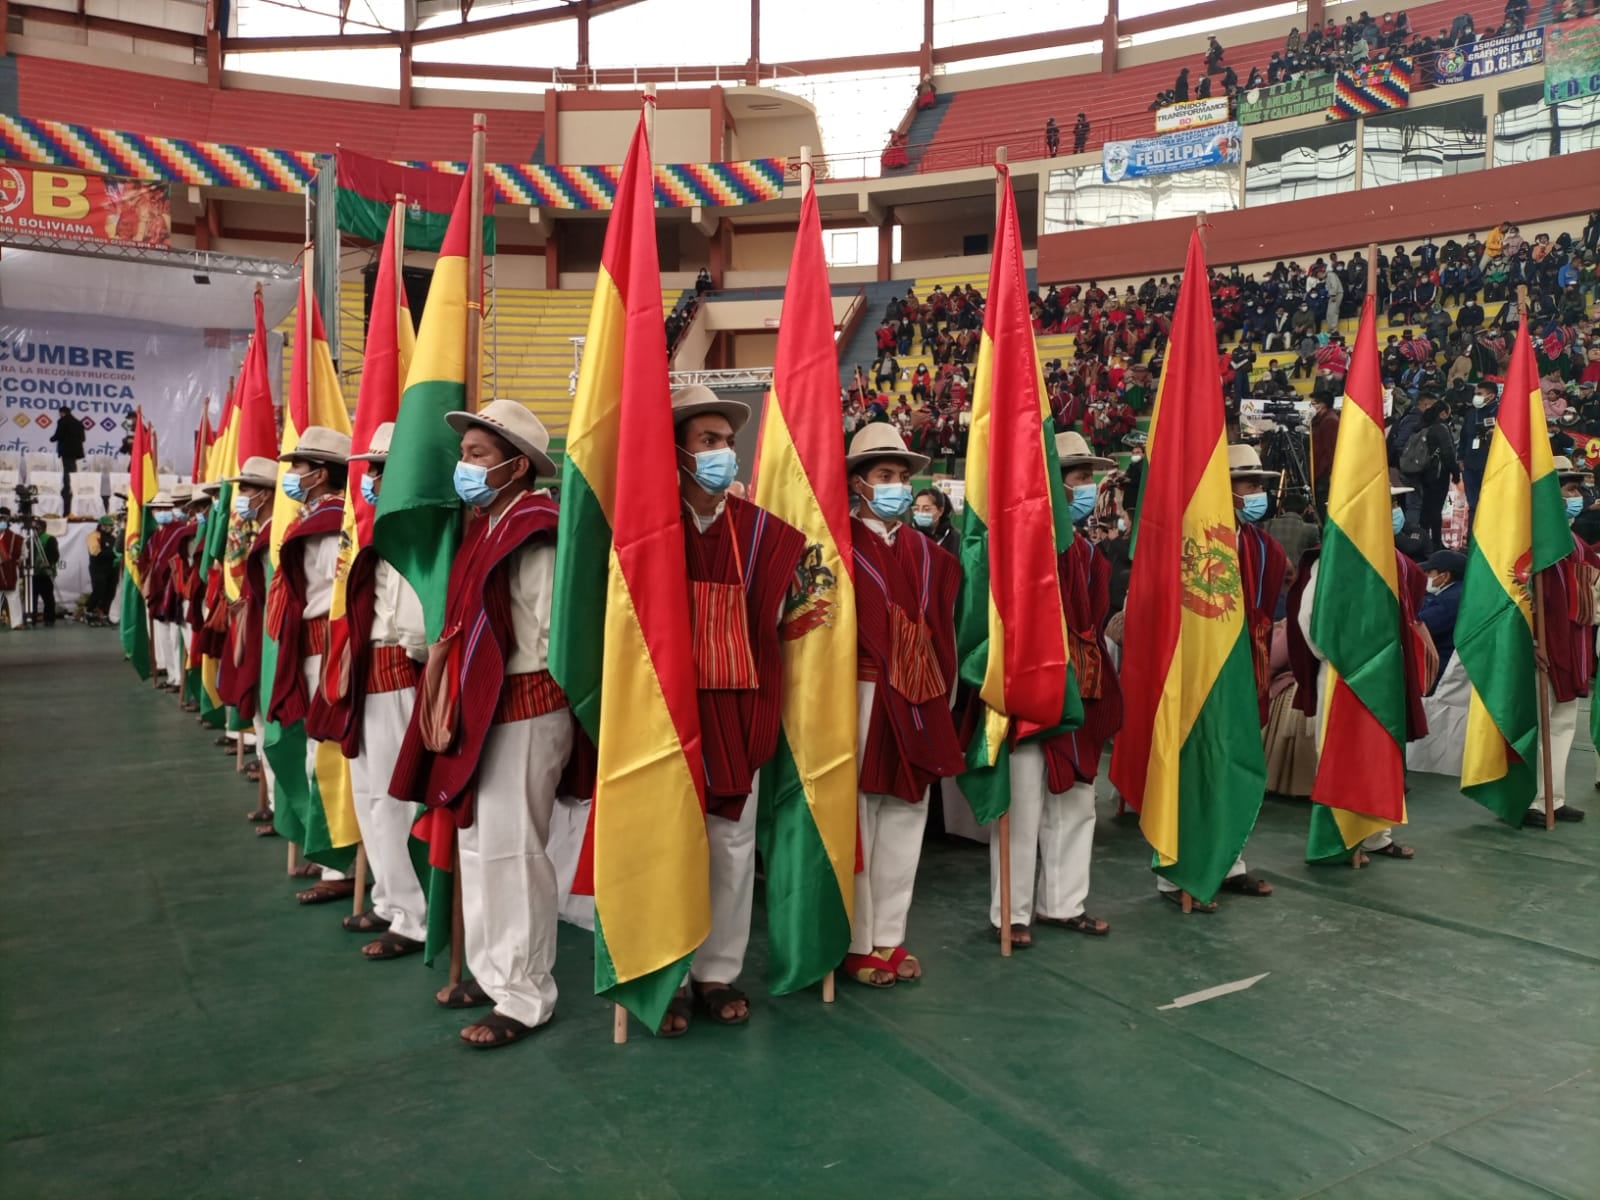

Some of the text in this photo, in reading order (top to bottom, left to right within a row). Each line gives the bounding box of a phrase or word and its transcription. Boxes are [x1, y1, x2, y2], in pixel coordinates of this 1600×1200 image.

[1511, 42, 1520, 51] EL
[1522, 37, 1542, 48] ALTO
[1526, 30, 1538, 40] DE
[1157, 102, 1227, 122] TRANSFORMAMOS
[1174, 100, 1207, 112] UNIDOS
[1135, 142, 1214, 167] FEDELPAZ
[32, 170, 91, 220] B
[18, 217, 94, 235] BOLIVIANA
[20, 366, 33, 375] LA
[0, 377, 134, 400] CONÓMICA
